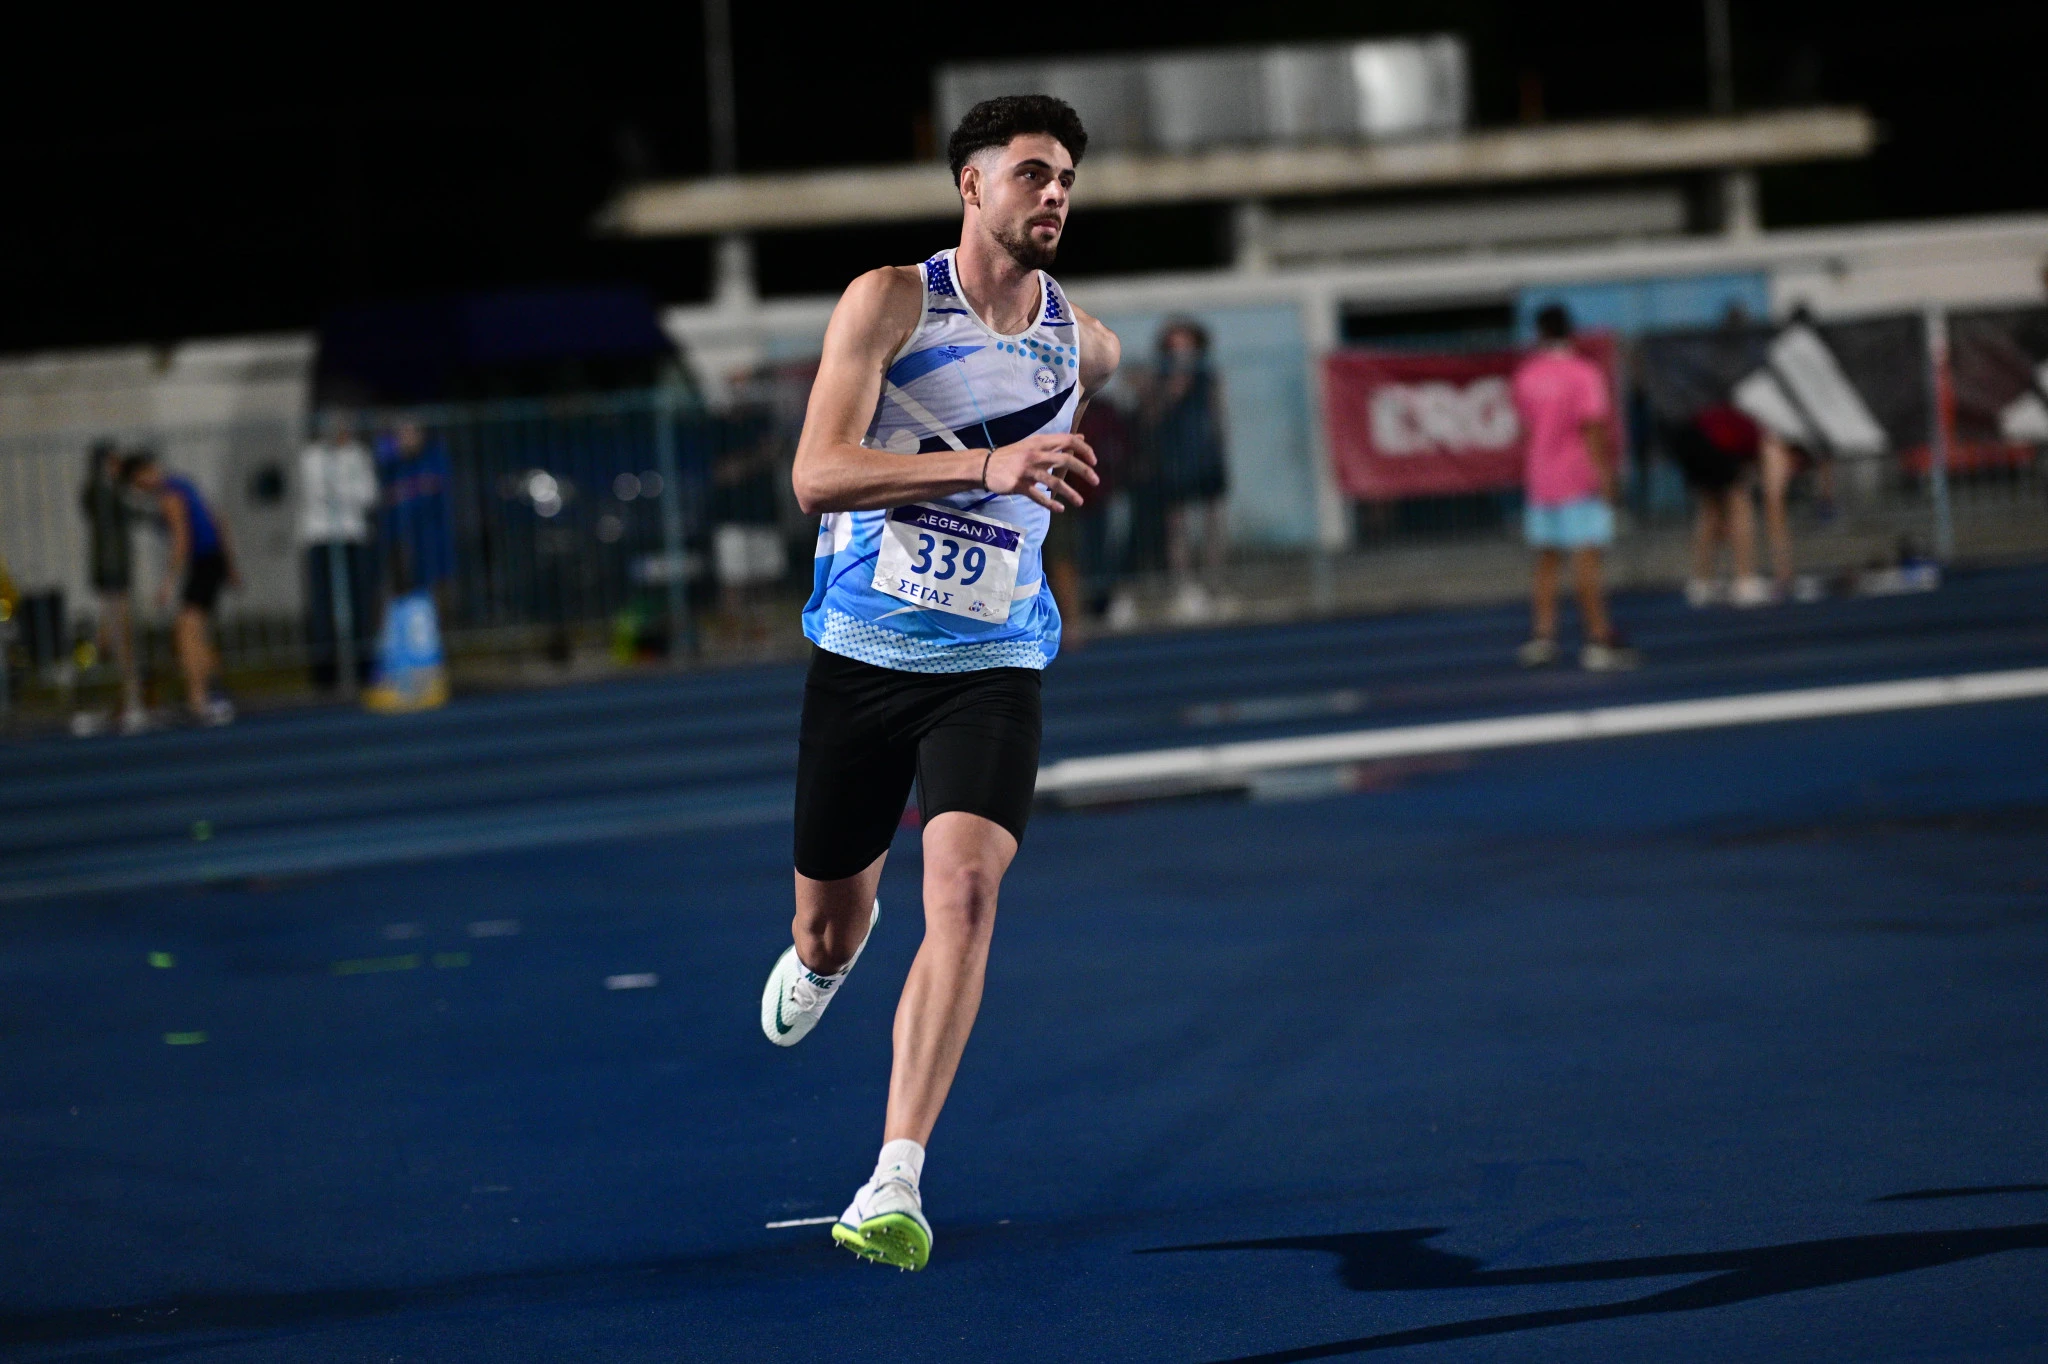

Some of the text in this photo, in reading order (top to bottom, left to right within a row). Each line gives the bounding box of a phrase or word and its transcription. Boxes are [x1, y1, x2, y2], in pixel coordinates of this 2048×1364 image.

[916, 513, 983, 537] AEGEAN
[910, 533, 987, 586] 339
[897, 578, 954, 607] ΣΕΓΑΣ
[804, 971, 837, 989] NIKE
